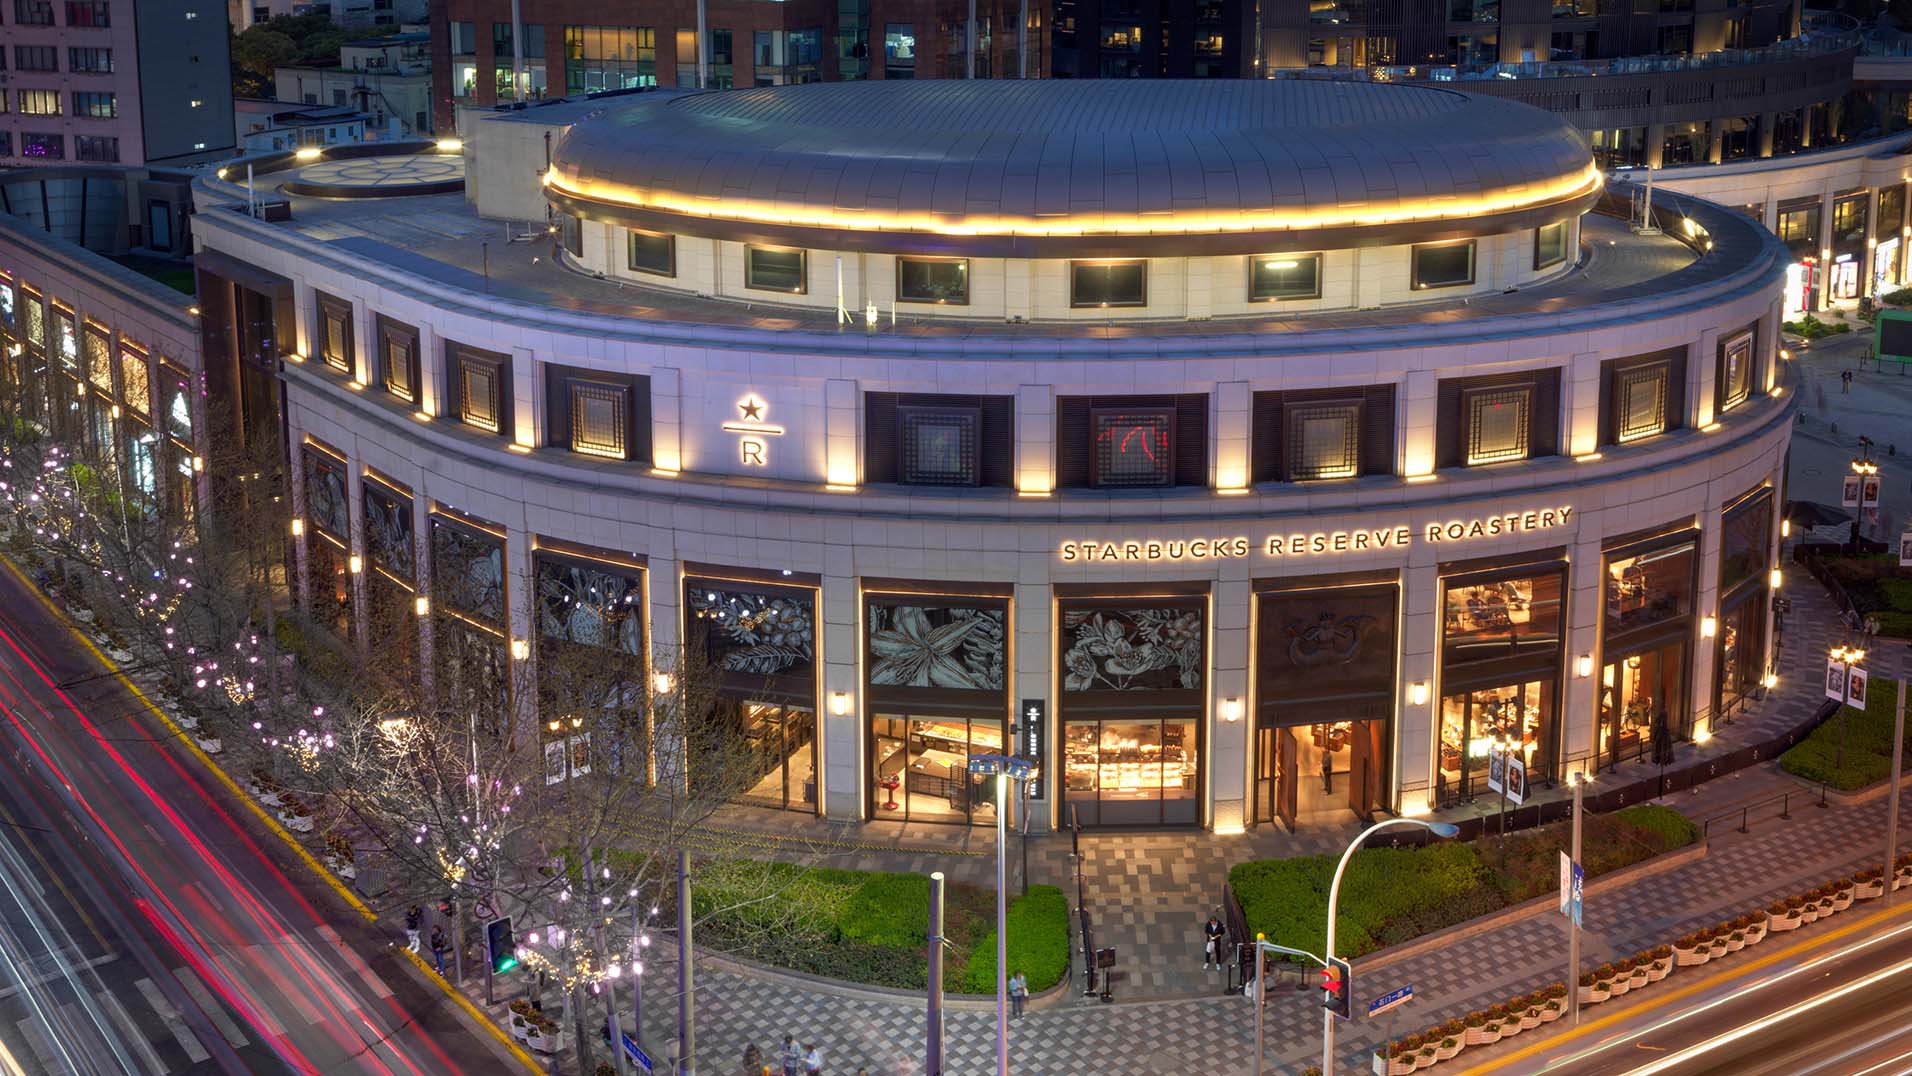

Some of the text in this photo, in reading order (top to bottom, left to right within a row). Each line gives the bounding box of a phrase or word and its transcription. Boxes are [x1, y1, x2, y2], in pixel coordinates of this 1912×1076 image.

[742, 440, 763, 465] R
[1063, 507, 1573, 561] STARBUCKS RESERVE ROASTERY
